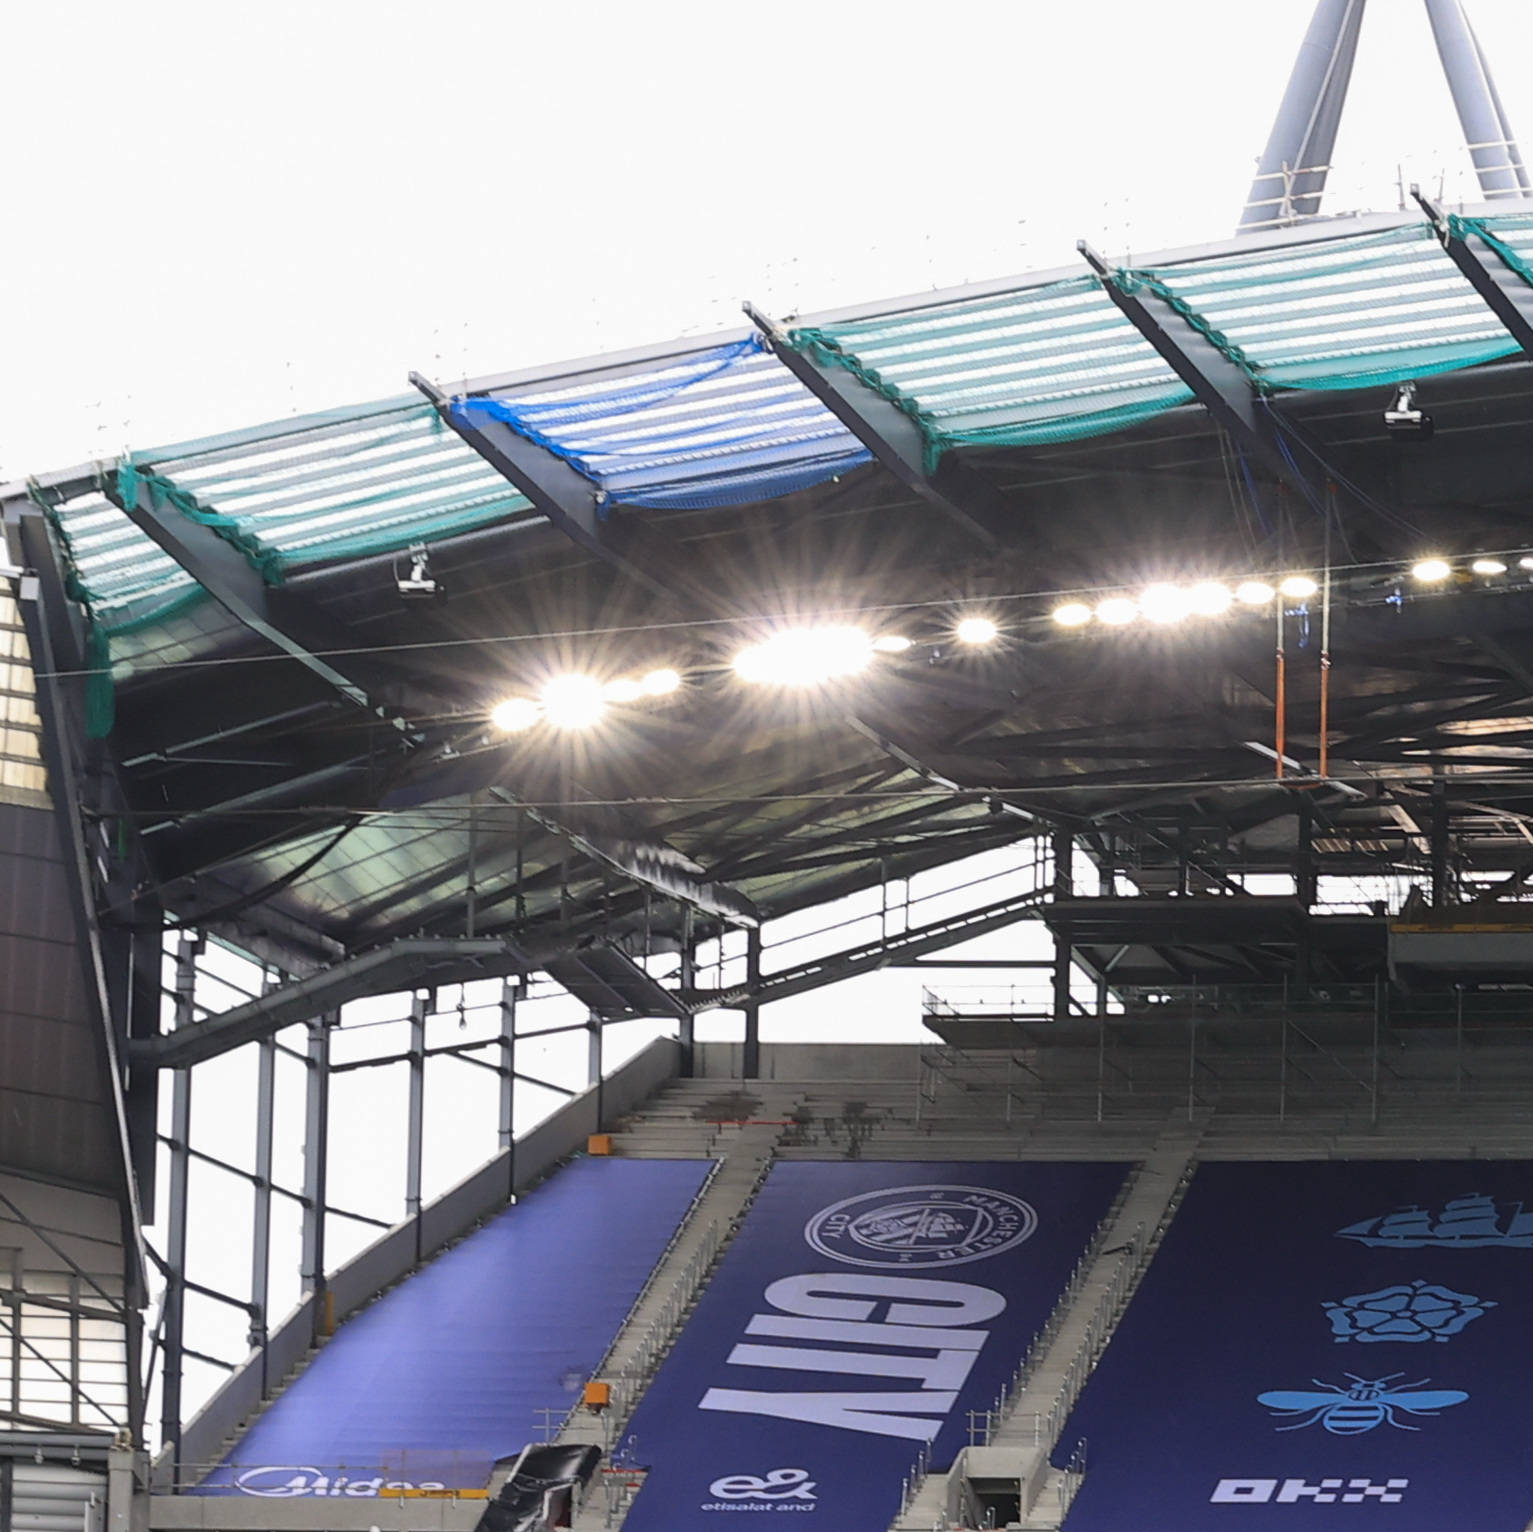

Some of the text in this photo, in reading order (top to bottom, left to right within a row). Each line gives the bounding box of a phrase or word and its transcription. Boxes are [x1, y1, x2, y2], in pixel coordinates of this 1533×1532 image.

[699, 1273, 1006, 1441] CITY
[709, 1468, 818, 1499] e&
[1210, 1478, 1409, 1503] OKX
[700, 1502, 816, 1511] etisalat and
